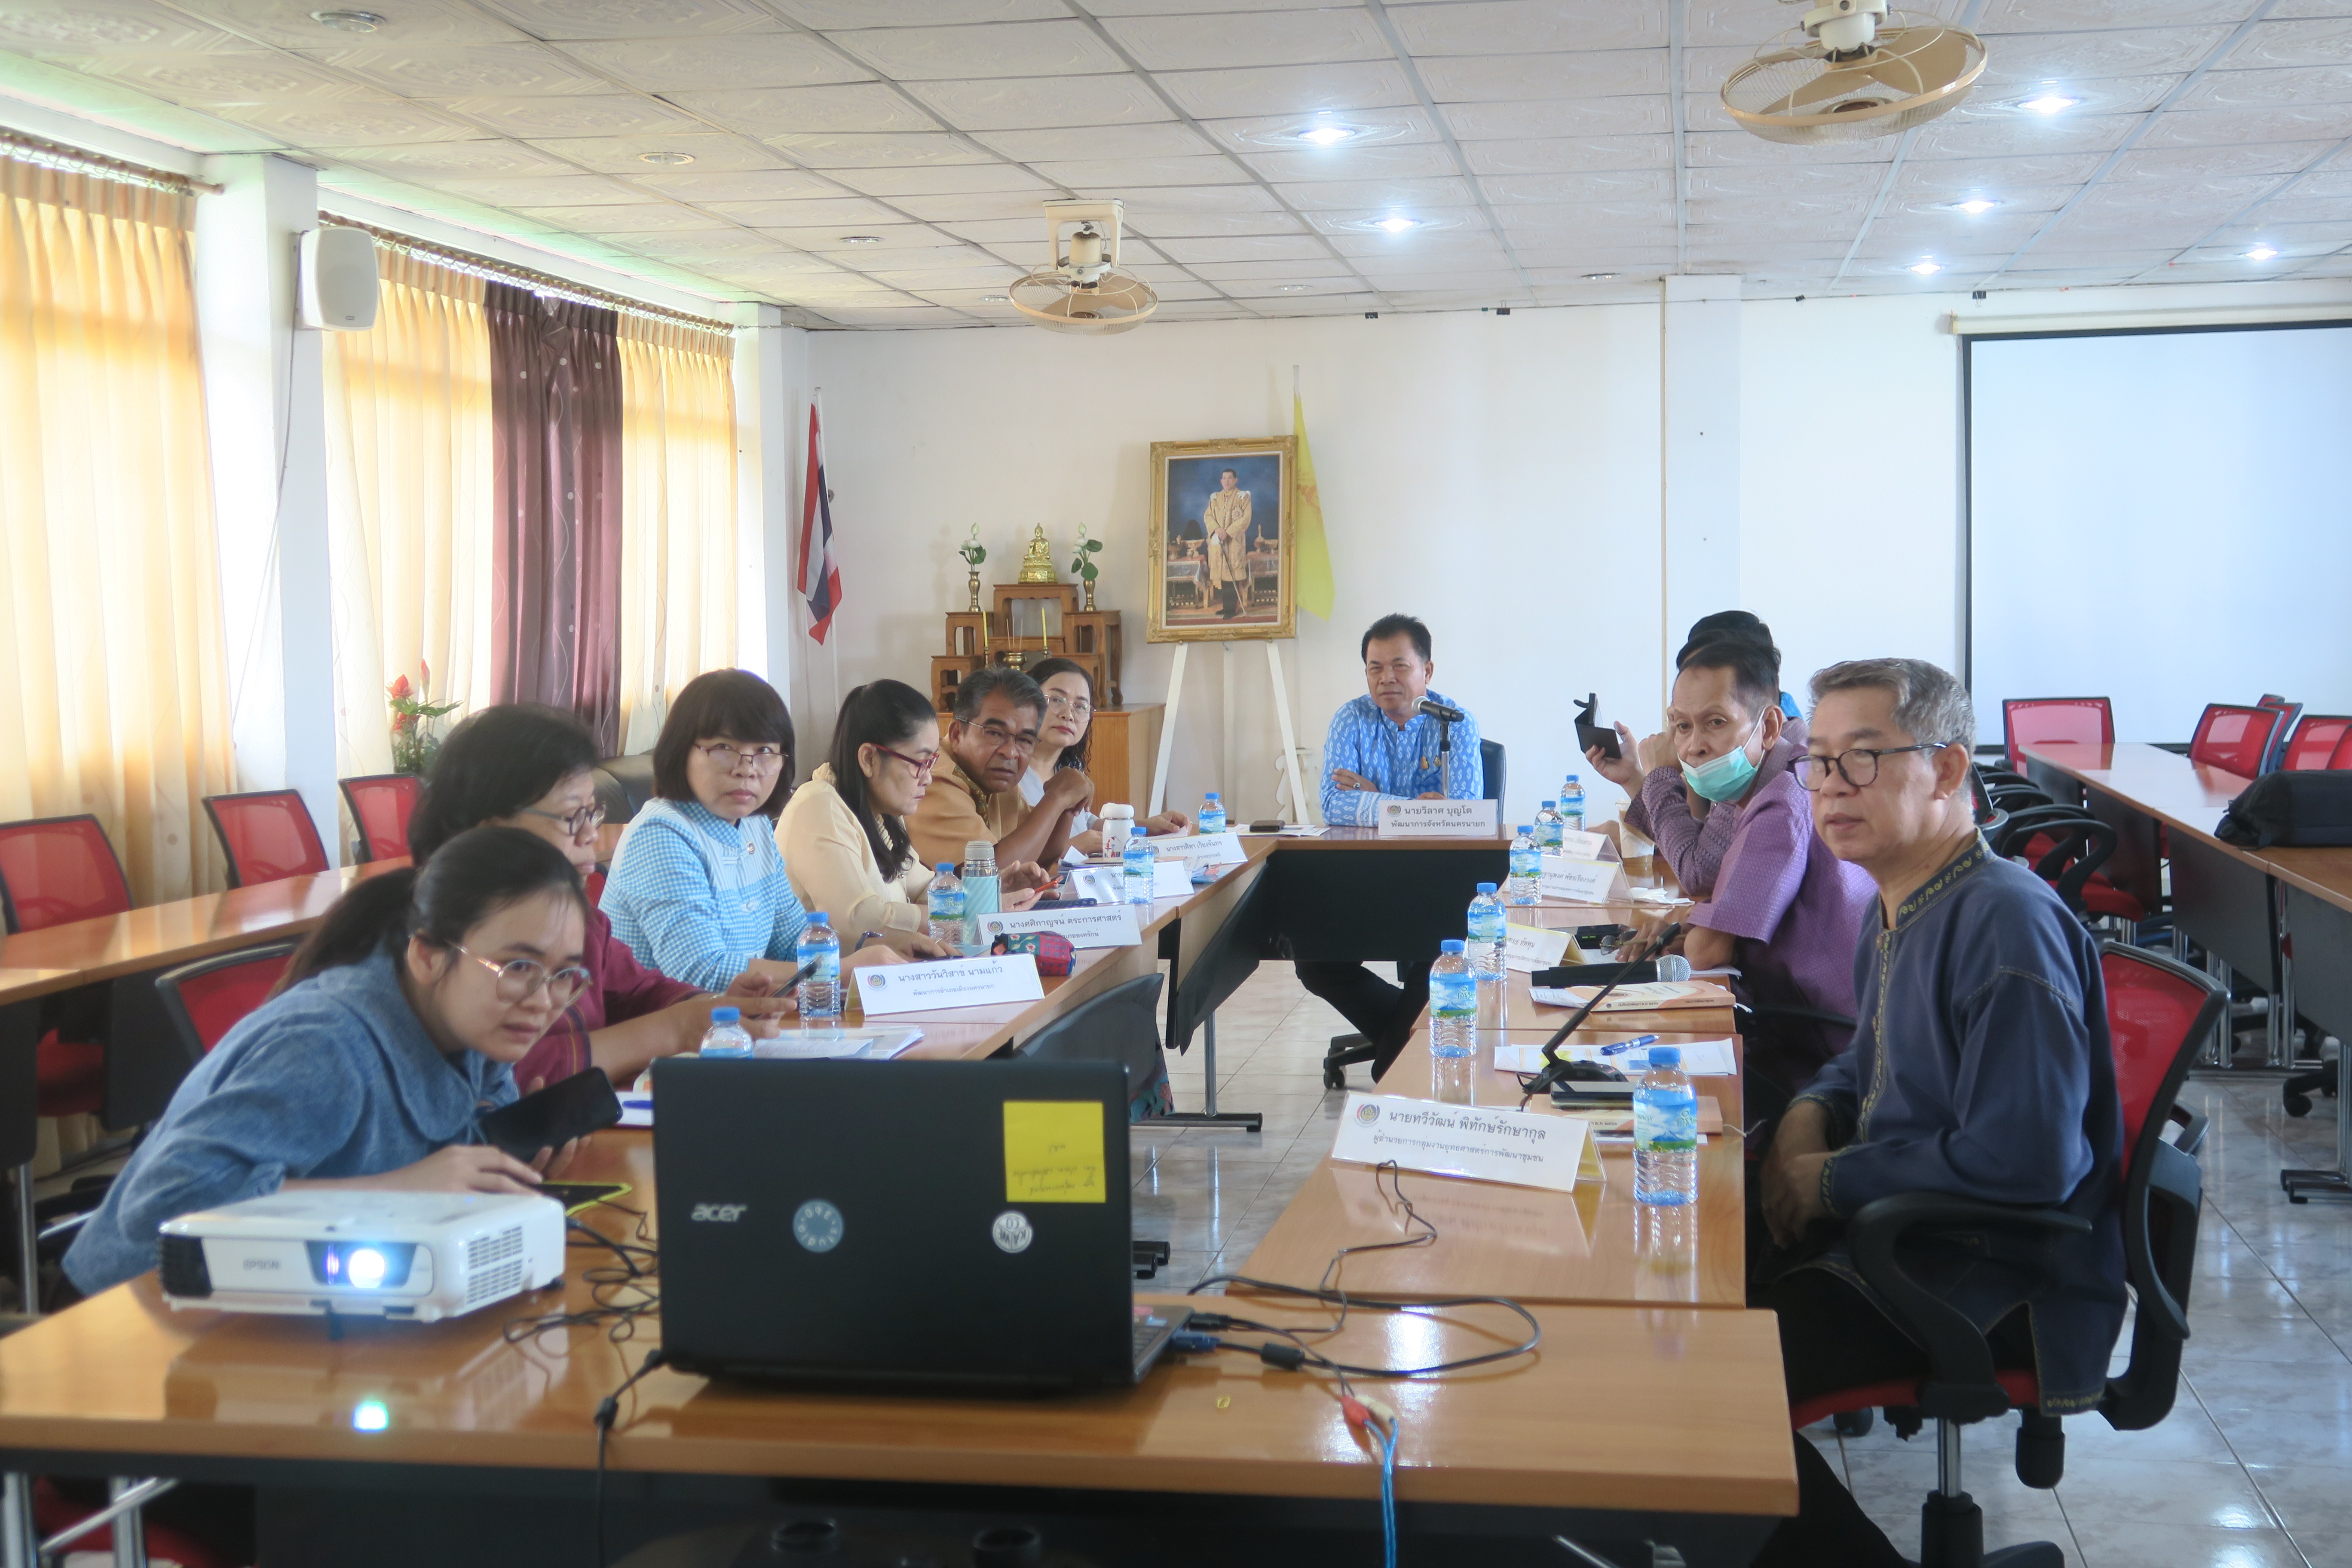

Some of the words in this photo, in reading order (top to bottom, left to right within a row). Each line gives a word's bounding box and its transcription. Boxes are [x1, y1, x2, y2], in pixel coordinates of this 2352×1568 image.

[1404, 805, 1444, 815] นายวิลาศ
[1447, 805, 1472, 816] บุญโต
[1391, 819, 1485, 828] พัฒนาการจังหวัดนครนายก
[1009, 916, 1065, 930] นางศศิกาญจน์
[1067, 910, 1122, 926] ตระการศาสตร์
[898, 964, 965, 982] นางสาววันวิสาข์
[968, 960, 1003, 976] นามแก้ว
[912, 983, 995, 996] พัฒนาการอำเภอเมืองนครนายก
[1389, 1110, 1458, 1130] นายทวีวัฒน์
[1459, 1115, 1547, 1141] พิทักษ์รักษากุล
[1373, 1130, 1544, 1163] ผู้อำนวยการกลุ่มงานยุทธศาสตร์การพัฒนาชุมชน
[690, 1202, 747, 1222] acer
[242, 1259, 279, 1271] EPSON
